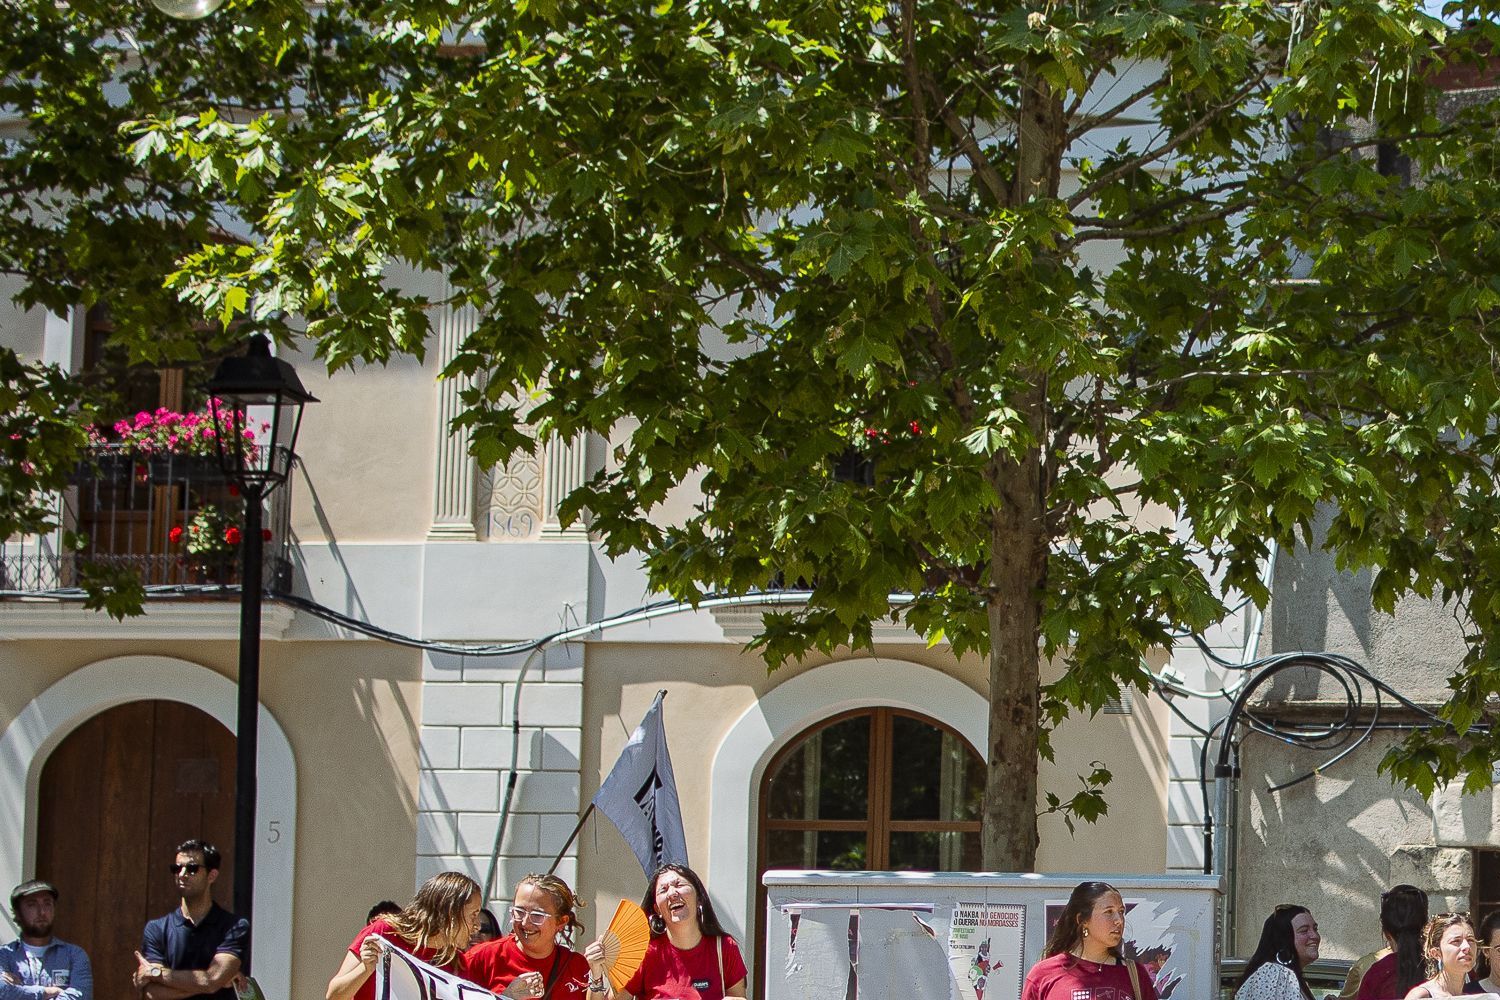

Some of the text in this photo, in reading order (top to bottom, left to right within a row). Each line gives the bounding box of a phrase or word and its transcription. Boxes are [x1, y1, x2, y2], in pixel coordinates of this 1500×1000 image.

[486, 512, 533, 538] 1869
[268, 821, 280, 844] 5
[958, 918, 979, 926] GUERRA
[960, 911, 979, 919] NAKBA
[990, 912, 1019, 920] GENOCIDIS
